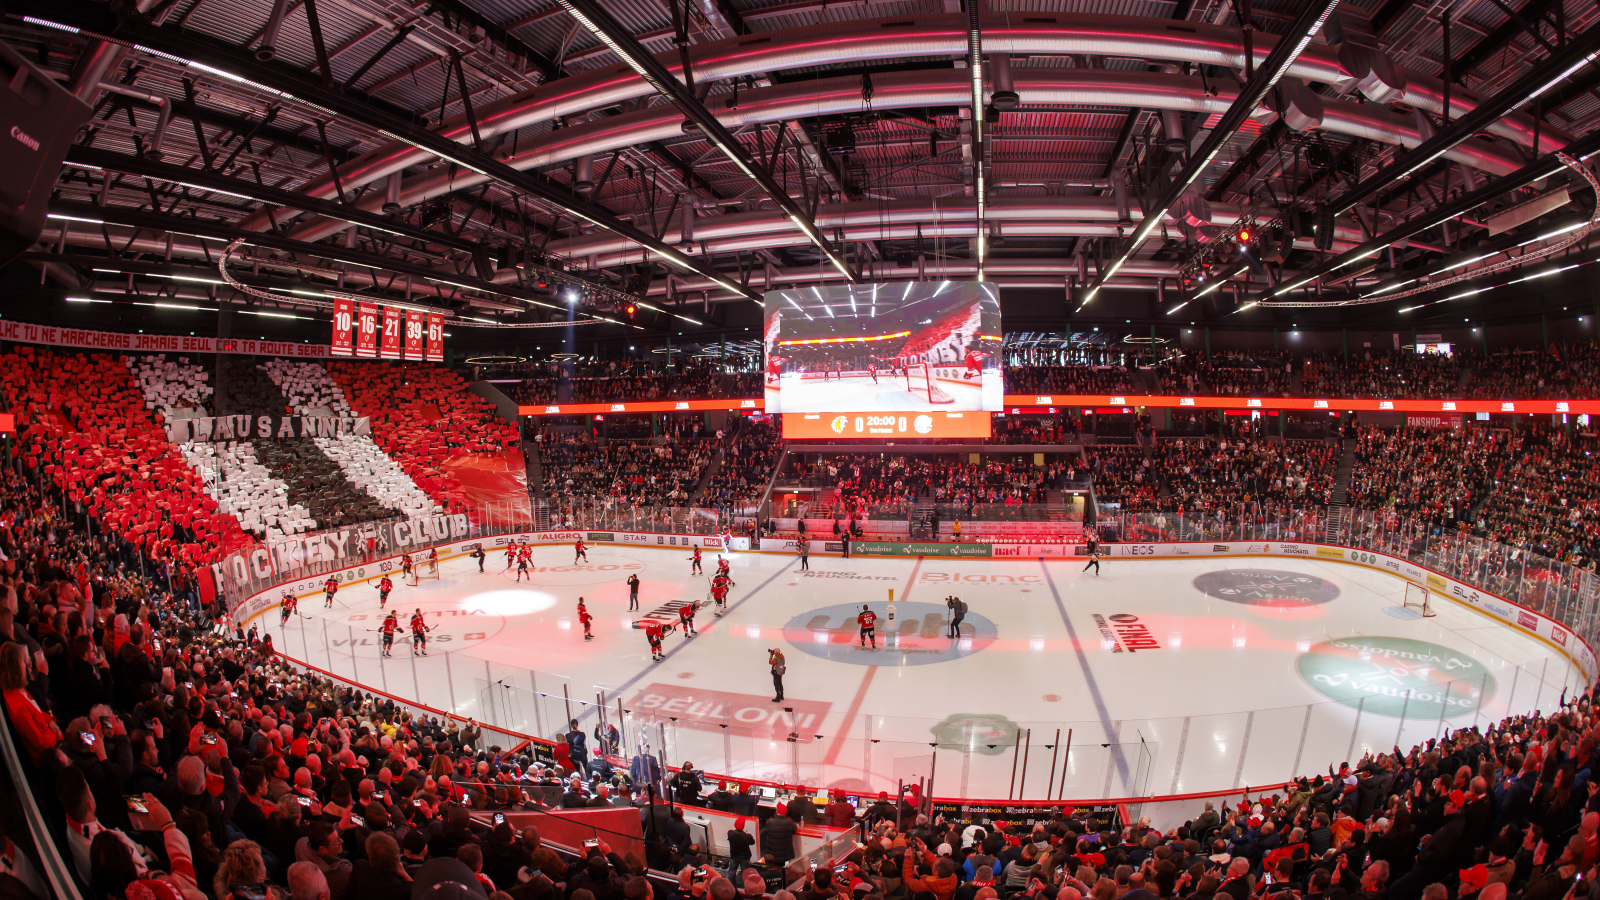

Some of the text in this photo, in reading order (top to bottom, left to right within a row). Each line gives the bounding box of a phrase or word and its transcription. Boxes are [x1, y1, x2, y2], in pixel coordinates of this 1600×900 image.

[10, 125, 40, 151] Canon
[335, 312, 350, 331] 10
[361, 316, 374, 334] 16
[385, 318, 398, 336] 21
[407, 321, 421, 339] 39
[430, 324, 441, 341] 61
[24, 325, 38, 340] TU
[42, 328, 56, 342] NE
[60, 330, 130, 348] MARCHERAS
[135, 336, 178, 349] JAMAIS
[183, 338, 211, 351] SEUL
[242, 341, 255, 352] TA
[260, 343, 293, 354] ROUTE
[298, 345, 324, 356] SERA
[192, 415, 354, 441] LAUSANNE
[856, 419, 864, 432] 0
[867, 416, 895, 426] 20:00
[899, 417, 907, 432] 0
[1408, 417, 1441, 427] FANSHOP
[394, 514, 467, 546] CLUB
[541, 532, 581, 540] ALIGRO
[866, 545, 892, 553] vaudoise
[912, 546, 939, 554] vaudoise
[960, 546, 987, 555] vaudoise
[995, 545, 1022, 555] naef
[1121, 545, 1154, 555] INEOS
[920, 571, 1042, 582] Blanc
[1407, 568, 1419, 577] VILLARS
[1484, 603, 1508, 617] HIRSLANDEN
[332, 634, 452, 646] VILARS
[1113, 624, 1161, 652] FINAL
[1553, 628, 1565, 643] Blick
[1335, 641, 1442, 663] vaudoise
[1350, 681, 1473, 708] vaudoise
[636, 693, 817, 728] BELLONI
[969, 805, 1002, 813] zebrabox
